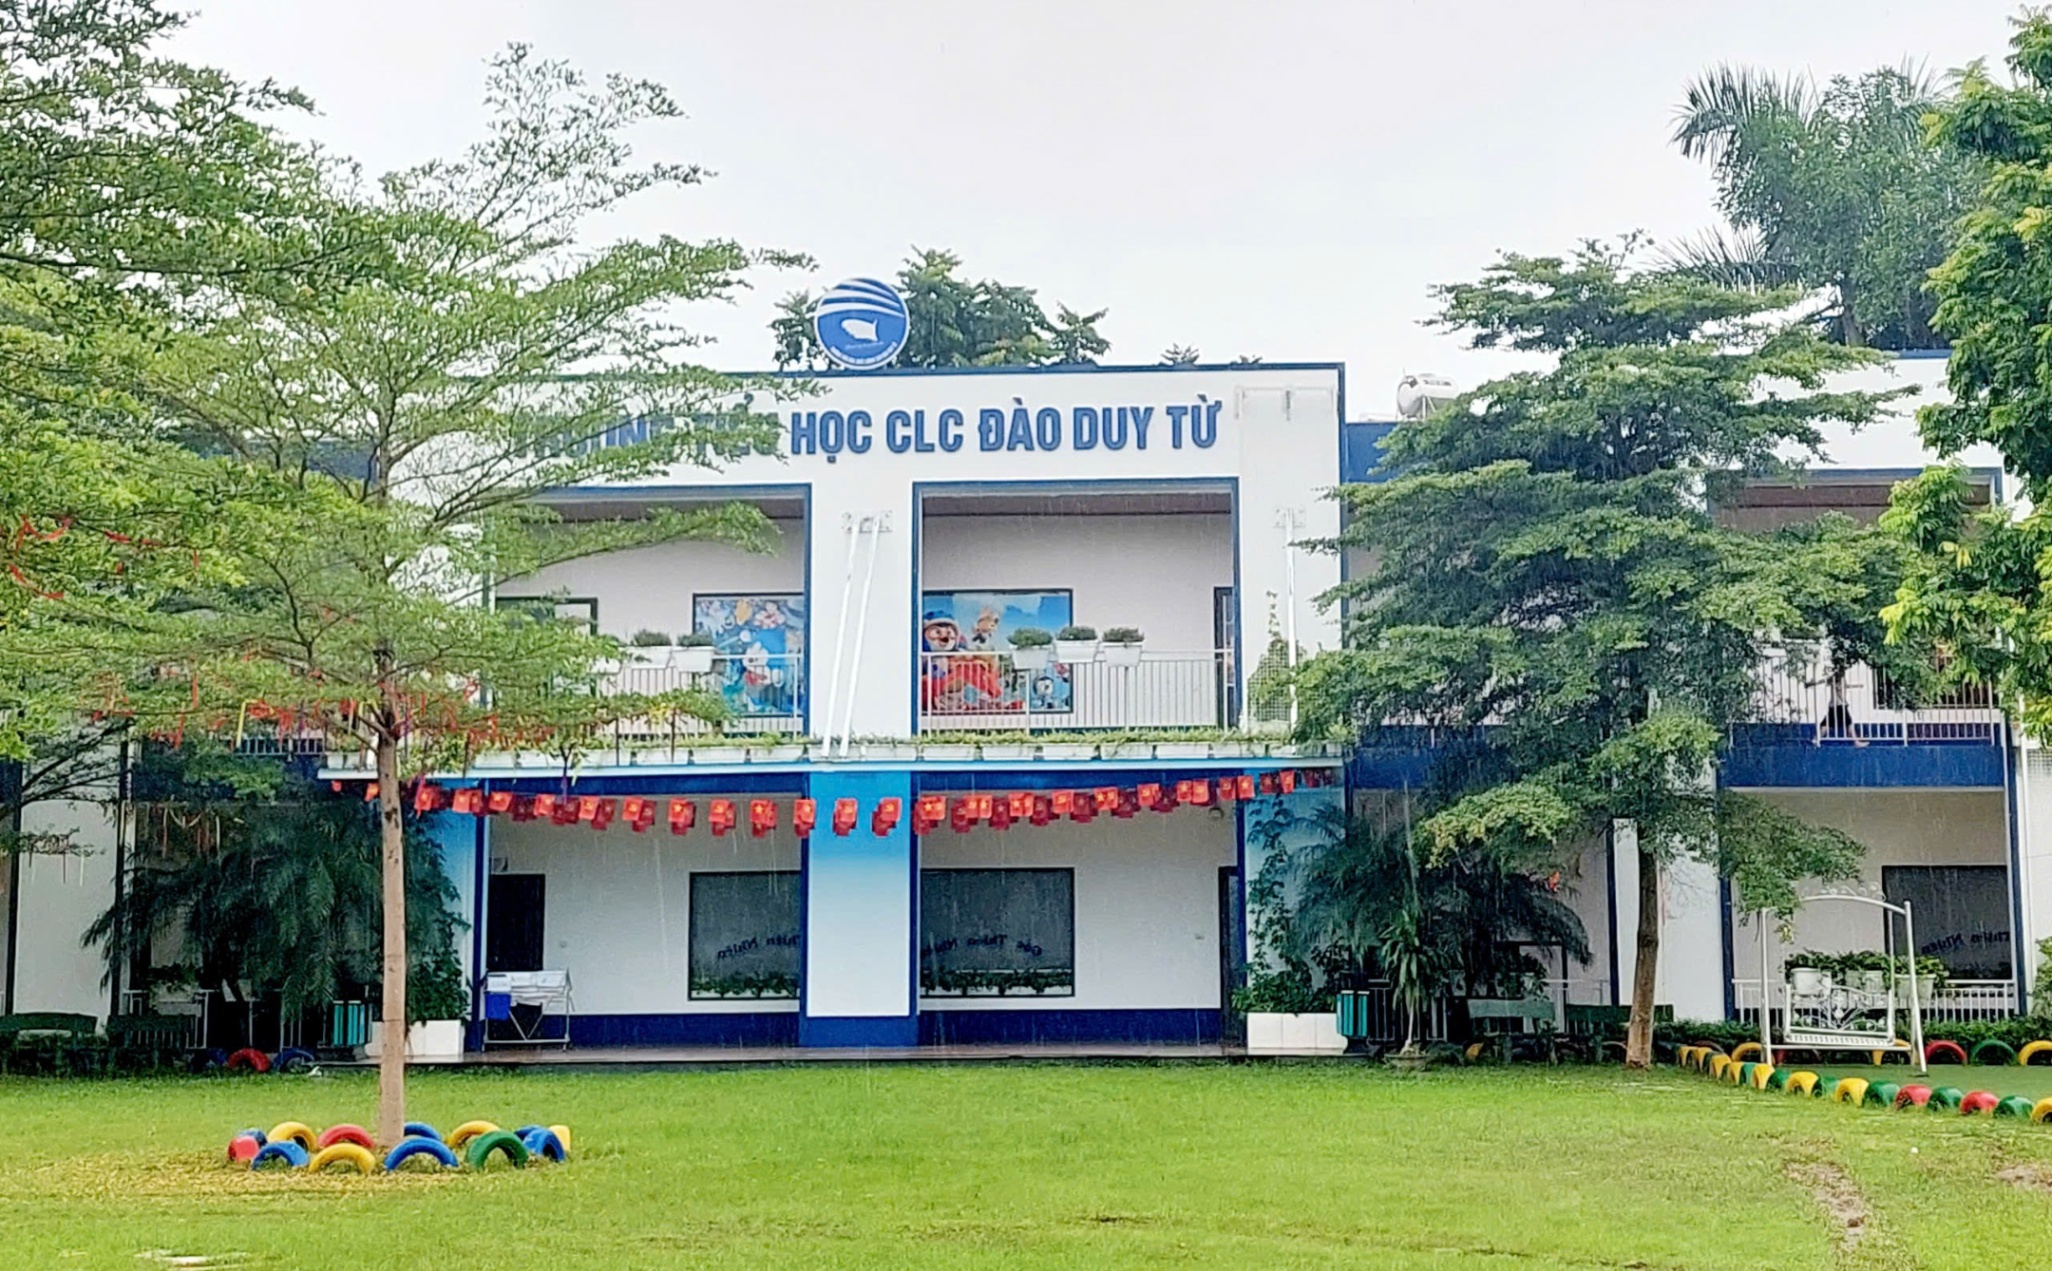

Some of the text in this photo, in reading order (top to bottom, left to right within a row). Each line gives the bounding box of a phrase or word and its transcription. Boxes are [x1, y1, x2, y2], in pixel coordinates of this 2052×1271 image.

[791, 411, 872, 463] HỌC
[886, 409, 964, 454] CLC
[978, 397, 1062, 452] ĐÀO
[1073, 406, 1155, 451] DUY
[1165, 393, 1223, 449] TỪ
